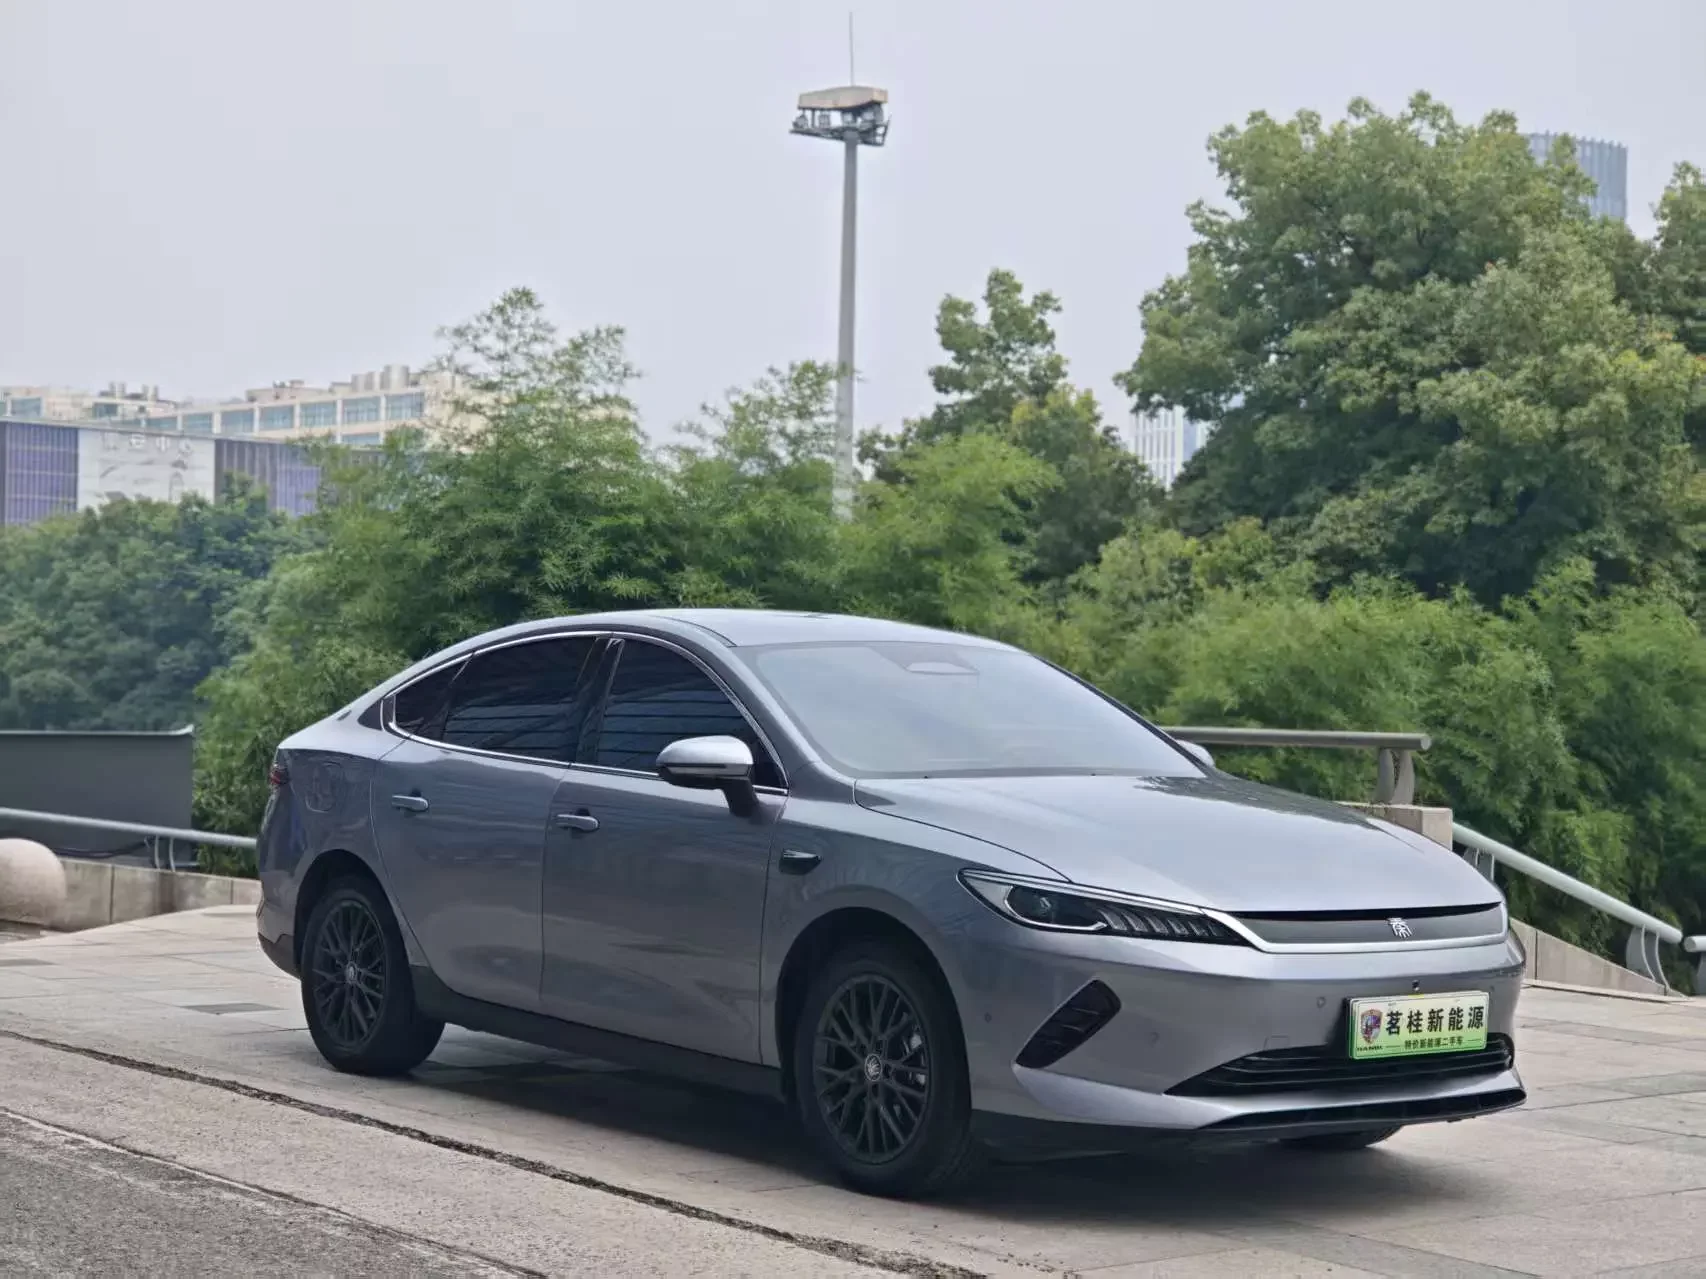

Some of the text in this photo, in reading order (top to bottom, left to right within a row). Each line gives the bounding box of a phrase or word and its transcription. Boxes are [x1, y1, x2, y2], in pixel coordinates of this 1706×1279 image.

[1386, 1006, 1485, 1035] 茗桂新能源
